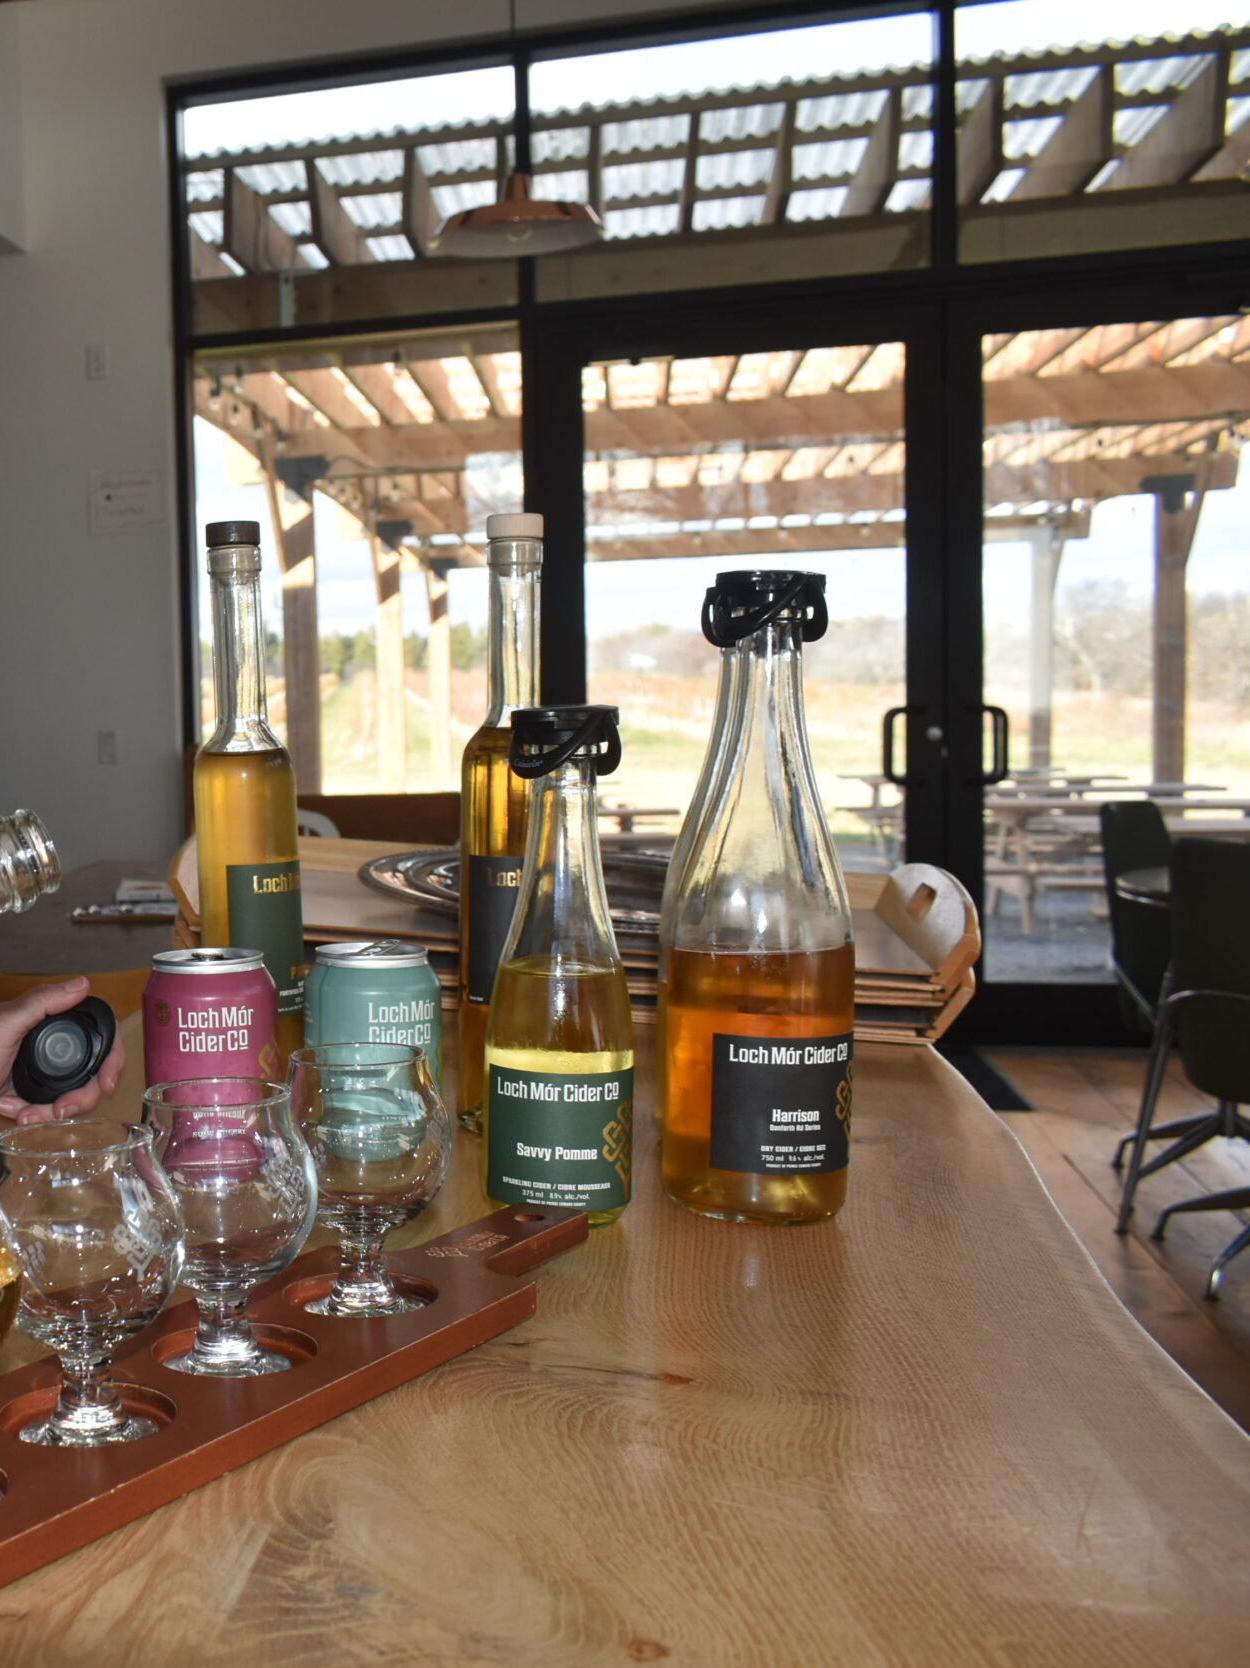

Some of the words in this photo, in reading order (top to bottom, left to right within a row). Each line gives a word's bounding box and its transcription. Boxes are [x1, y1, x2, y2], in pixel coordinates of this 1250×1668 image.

[253, 873, 287, 894] Loch
[178, 1007, 219, 1028] Loch
[221, 1005, 254, 1027] Mór
[369, 1001, 409, 1023] Loch
[410, 999, 435, 1022] Mór
[179, 1030, 225, 1052] Cider
[369, 1025, 414, 1047] Cider
[729, 1043, 768, 1064] Loch
[770, 1046, 802, 1065] Mór
[804, 1046, 836, 1065] Cider
[498, 1076, 528, 1099] Loch
[530, 1082, 562, 1101] Mór
[564, 1084, 603, 1102] Cider
[772, 1109, 820, 1122] Harrison
[517, 1142, 552, 1161] Savvy
[555, 1146, 598, 1160] Pomme
[522, 1189, 533, 1197] 375
[533, 1181, 551, 1189] CIDER
